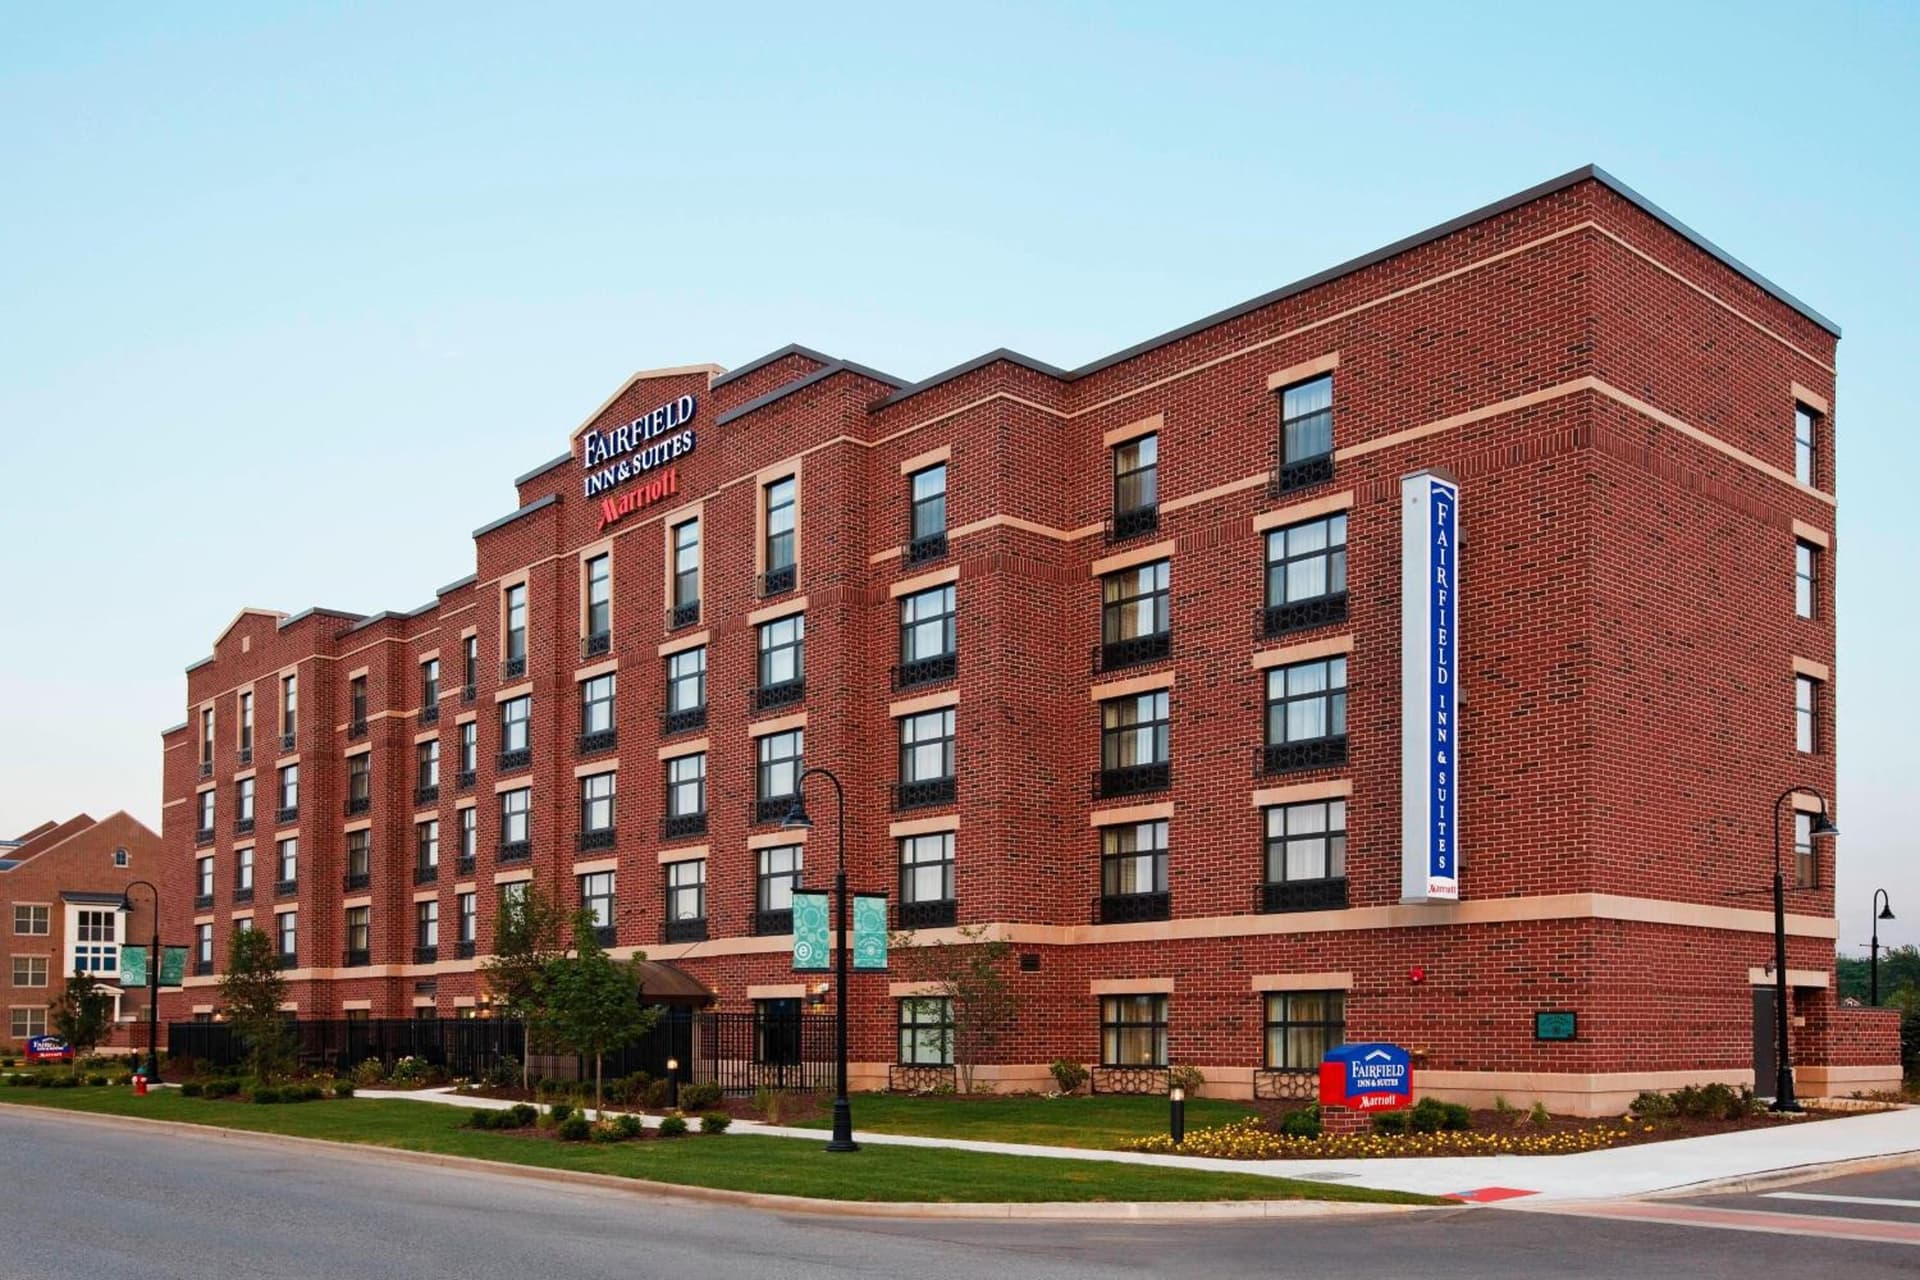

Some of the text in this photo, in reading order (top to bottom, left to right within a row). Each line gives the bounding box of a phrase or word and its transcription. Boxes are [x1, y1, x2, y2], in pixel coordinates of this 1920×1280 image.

[583, 394, 696, 469] FAIRFIELD
[583, 430, 694, 498] INN & SUITES
[597, 467, 678, 530] Marriott
[1436, 502, 1449, 869] FAIRFIELD INN & SUITES
[1352, 1061, 1404, 1078] FAIRFIELD
[1357, 1079, 1370, 1088] INN
[1359, 1094, 1396, 1109] Marriott
